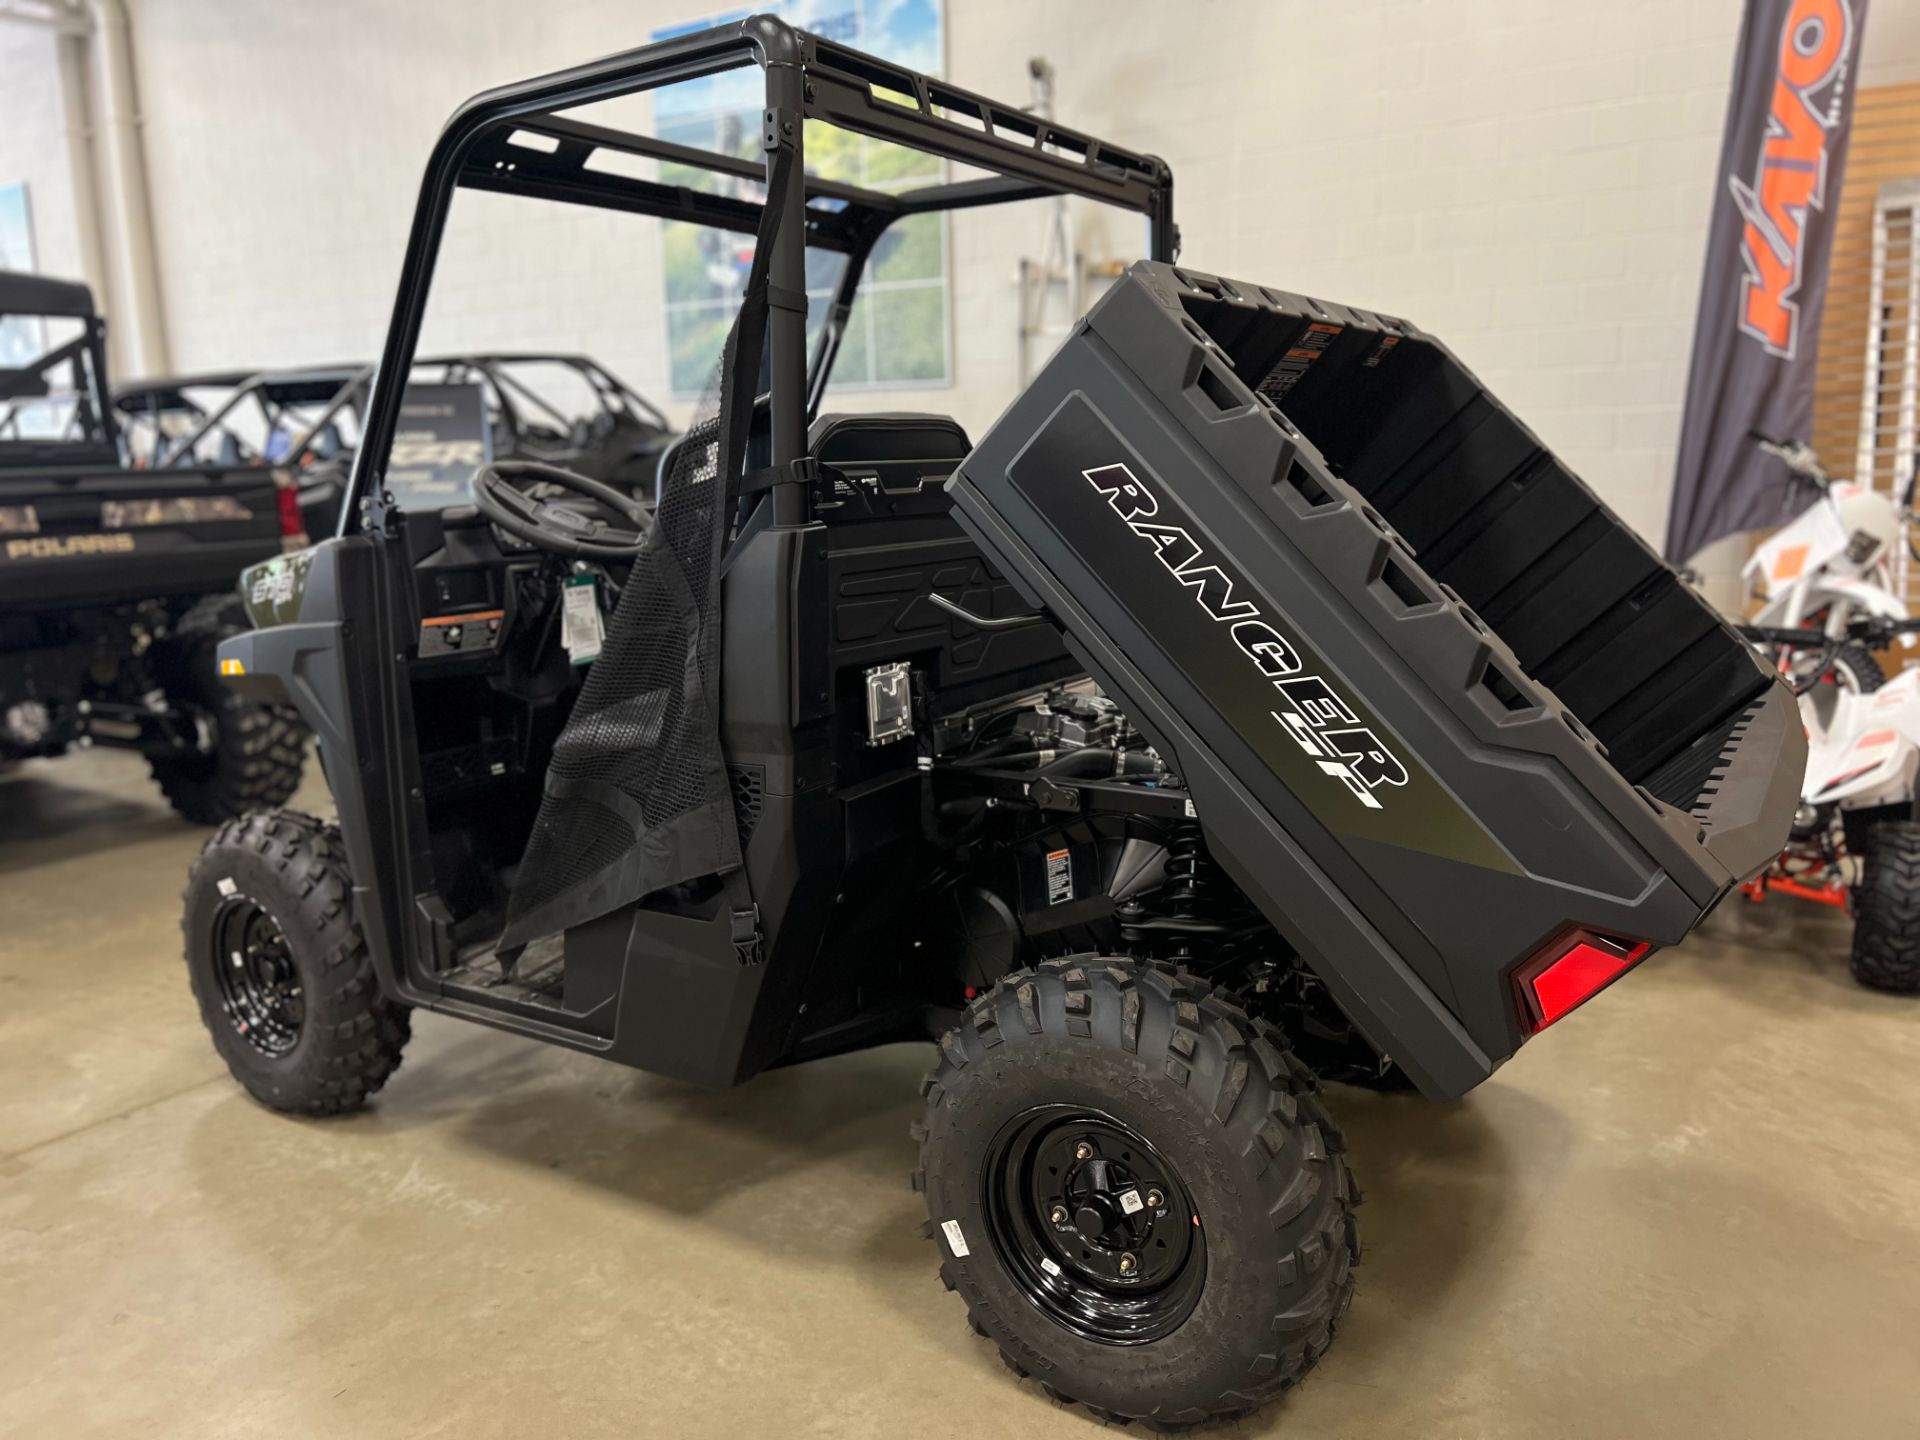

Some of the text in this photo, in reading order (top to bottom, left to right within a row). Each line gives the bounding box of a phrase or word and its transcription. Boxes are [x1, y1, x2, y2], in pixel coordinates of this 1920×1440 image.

[6, 533, 135, 560] POLARIS
[1081, 462, 1409, 788] RANGER
[1270, 711, 1384, 809] SP
